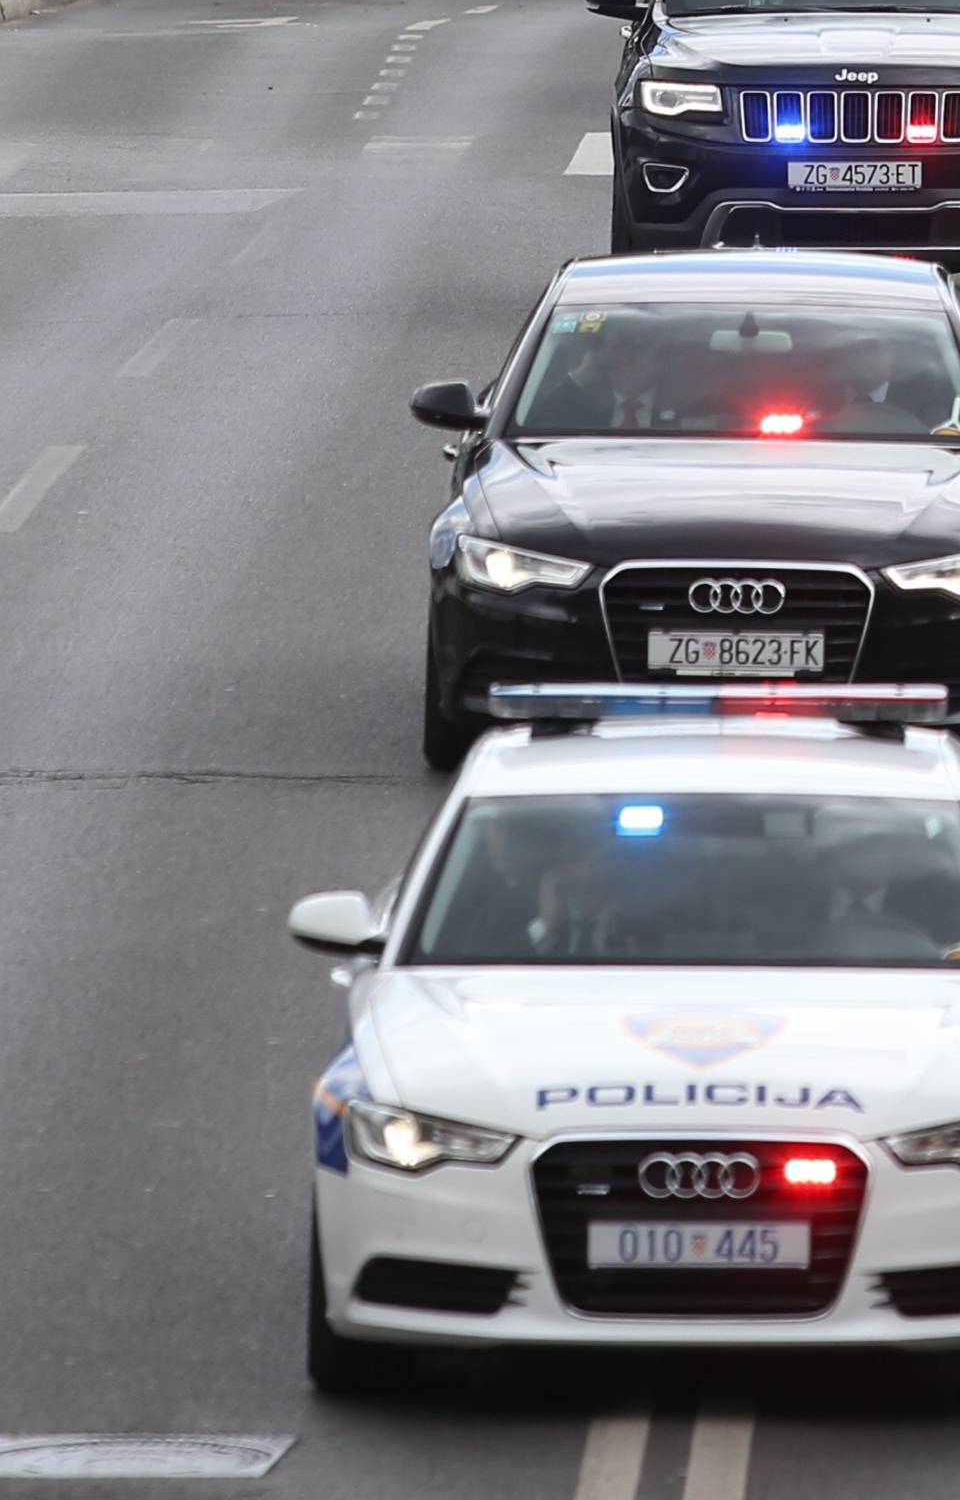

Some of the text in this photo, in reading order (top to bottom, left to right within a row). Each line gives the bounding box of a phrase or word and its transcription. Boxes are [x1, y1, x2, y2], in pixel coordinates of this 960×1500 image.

[834, 68, 879, 84] Jeep
[803, 164, 827, 185] ZG
[669, 638, 820, 666] ZG 8623-FK
[535, 1083, 865, 1114] POLICIJA
[618, 1228, 779, 1263] 010 445
